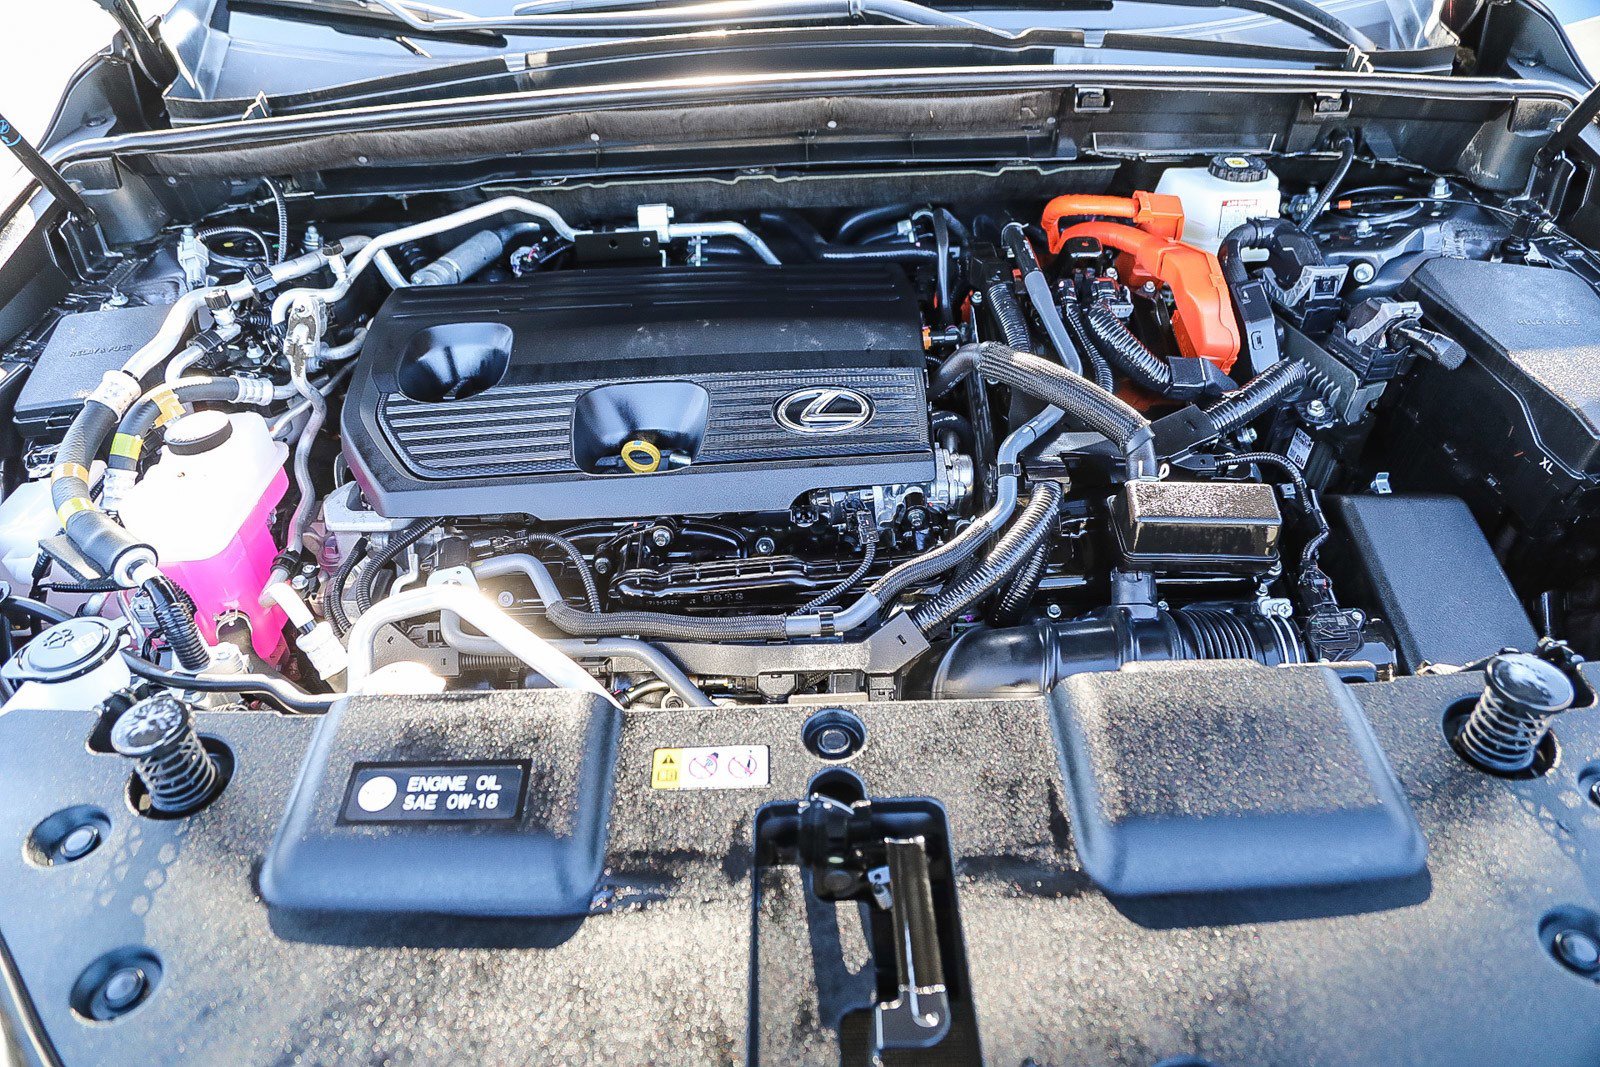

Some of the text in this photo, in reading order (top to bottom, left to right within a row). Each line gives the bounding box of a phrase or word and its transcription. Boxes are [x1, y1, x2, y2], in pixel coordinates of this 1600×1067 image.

[406, 774, 502, 793] ENGINE OIL
[402, 793, 499, 811] SAE 0W-16
